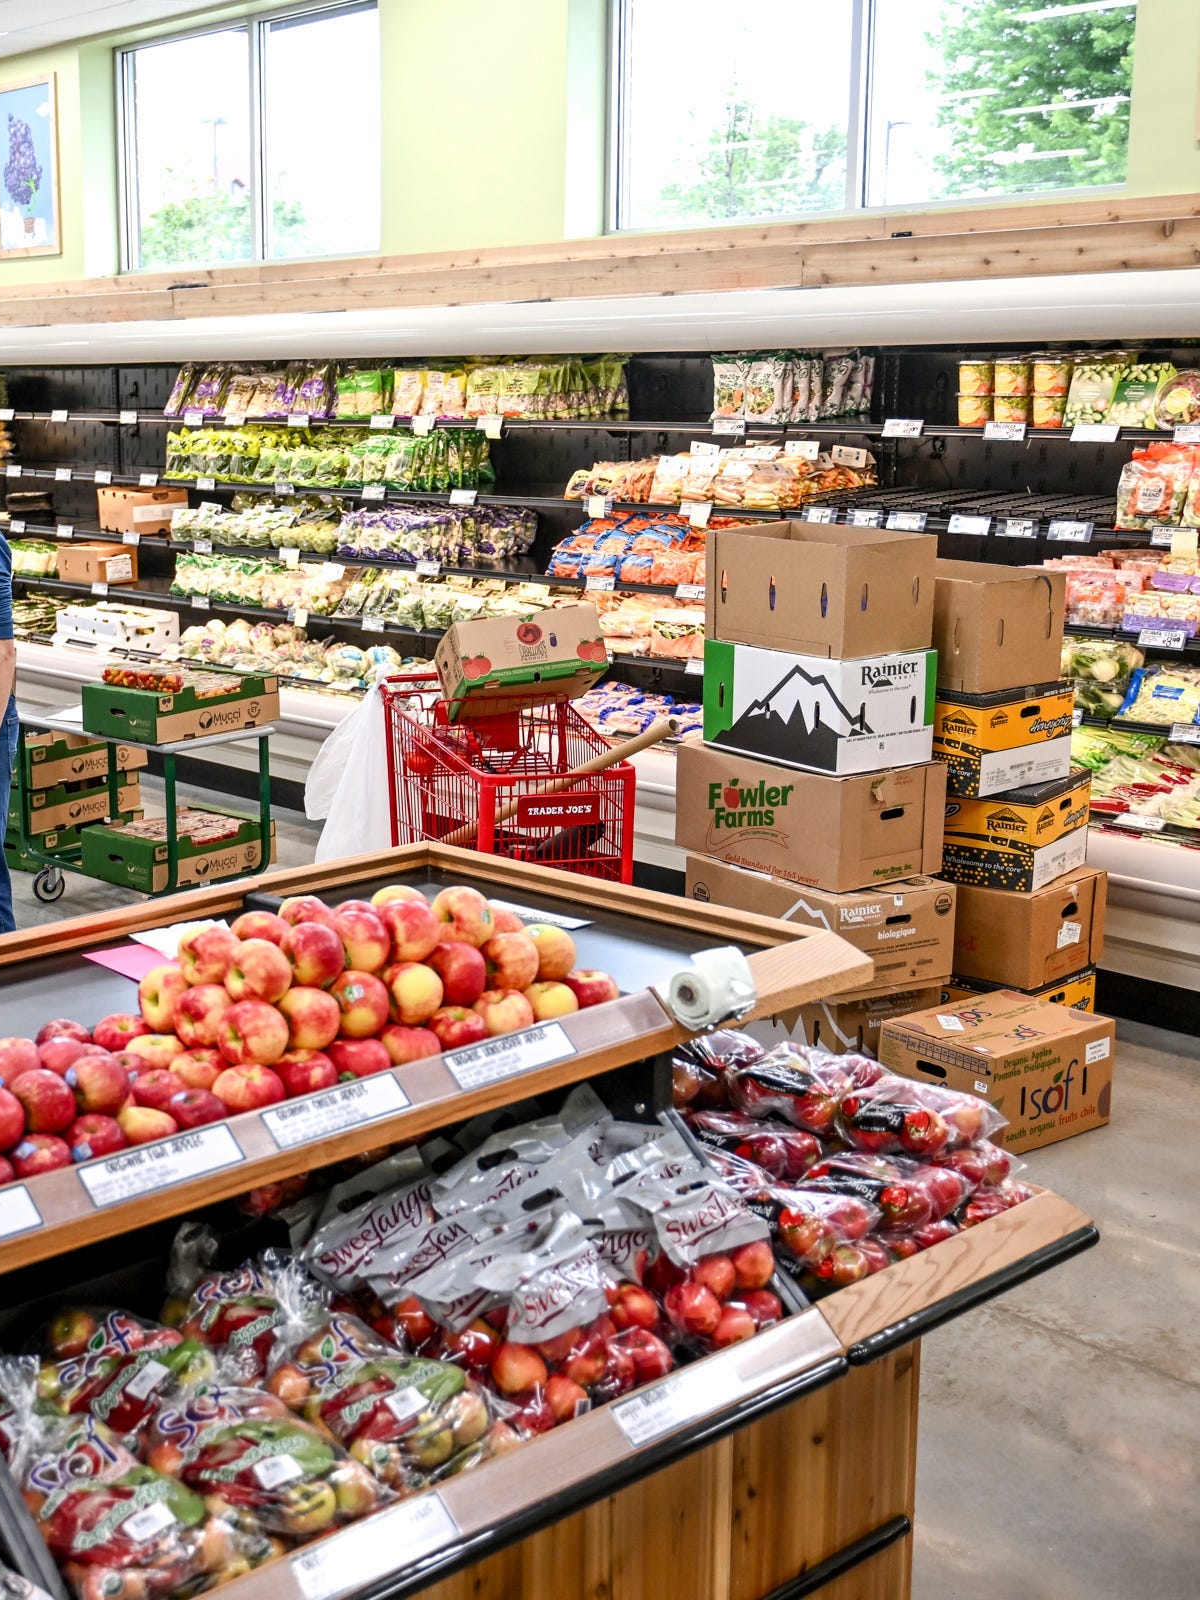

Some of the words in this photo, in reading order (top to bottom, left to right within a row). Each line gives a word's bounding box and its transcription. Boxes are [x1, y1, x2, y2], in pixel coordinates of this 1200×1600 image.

[861, 661, 918, 686] Rainier
[213, 708, 241, 723] Mucci
[941, 721, 977, 736] Rainier
[1029, 713, 1073, 737] Honeycrisp
[82, 798, 107, 812] Mucci
[528, 807, 563, 816] TRADER
[565, 805, 593, 814] JOE'S
[714, 806, 775, 829] Farms
[986, 819, 1028, 833] Rainier
[210, 853, 238, 869] Mucci
[725, 852, 741, 863] Gold
[740, 856, 772, 873] Standard
[771, 865, 782, 876] for
[796, 873, 820, 886] years!
[945, 855, 984, 868] Wholesome
[992, 861, 1005, 872] the
[840, 903, 882, 923] Rainier
[877, 926, 917, 941] biologique
[1031, 1048, 1053, 1061] Apples
[1005, 1128, 1027, 1143] south
[1029, 1120, 1057, 1137] organic
[1058, 1111, 1078, 1125] fruits
[1080, 1104, 1096, 1118] chile
[106, 1153, 146, 1174] ORGANIC
[172, 1135, 205, 1155] APPLES
